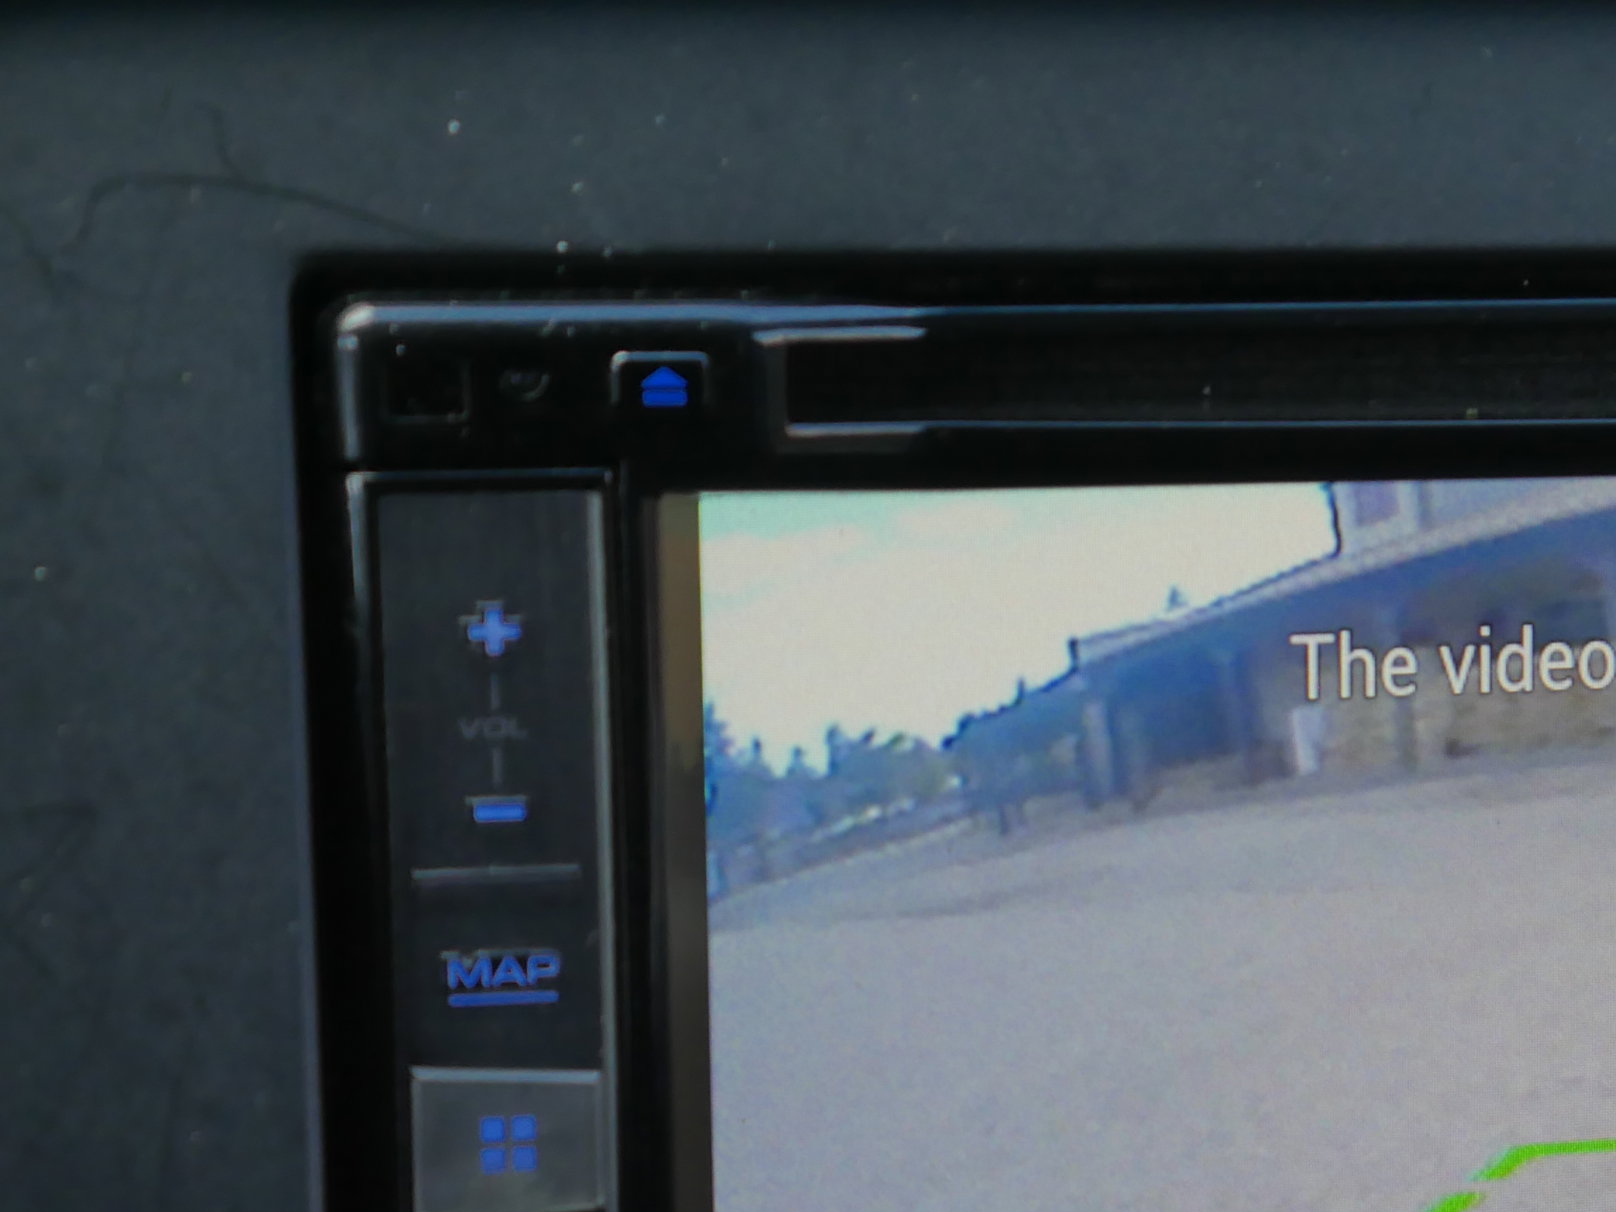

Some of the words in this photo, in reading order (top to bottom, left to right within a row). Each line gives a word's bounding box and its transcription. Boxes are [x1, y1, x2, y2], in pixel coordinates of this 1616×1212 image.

[1288, 628, 1419, 701] The
[1438, 623, 1616, 695] video
[458, 716, 528, 741] VOL
[444, 950, 561, 990] MAP
